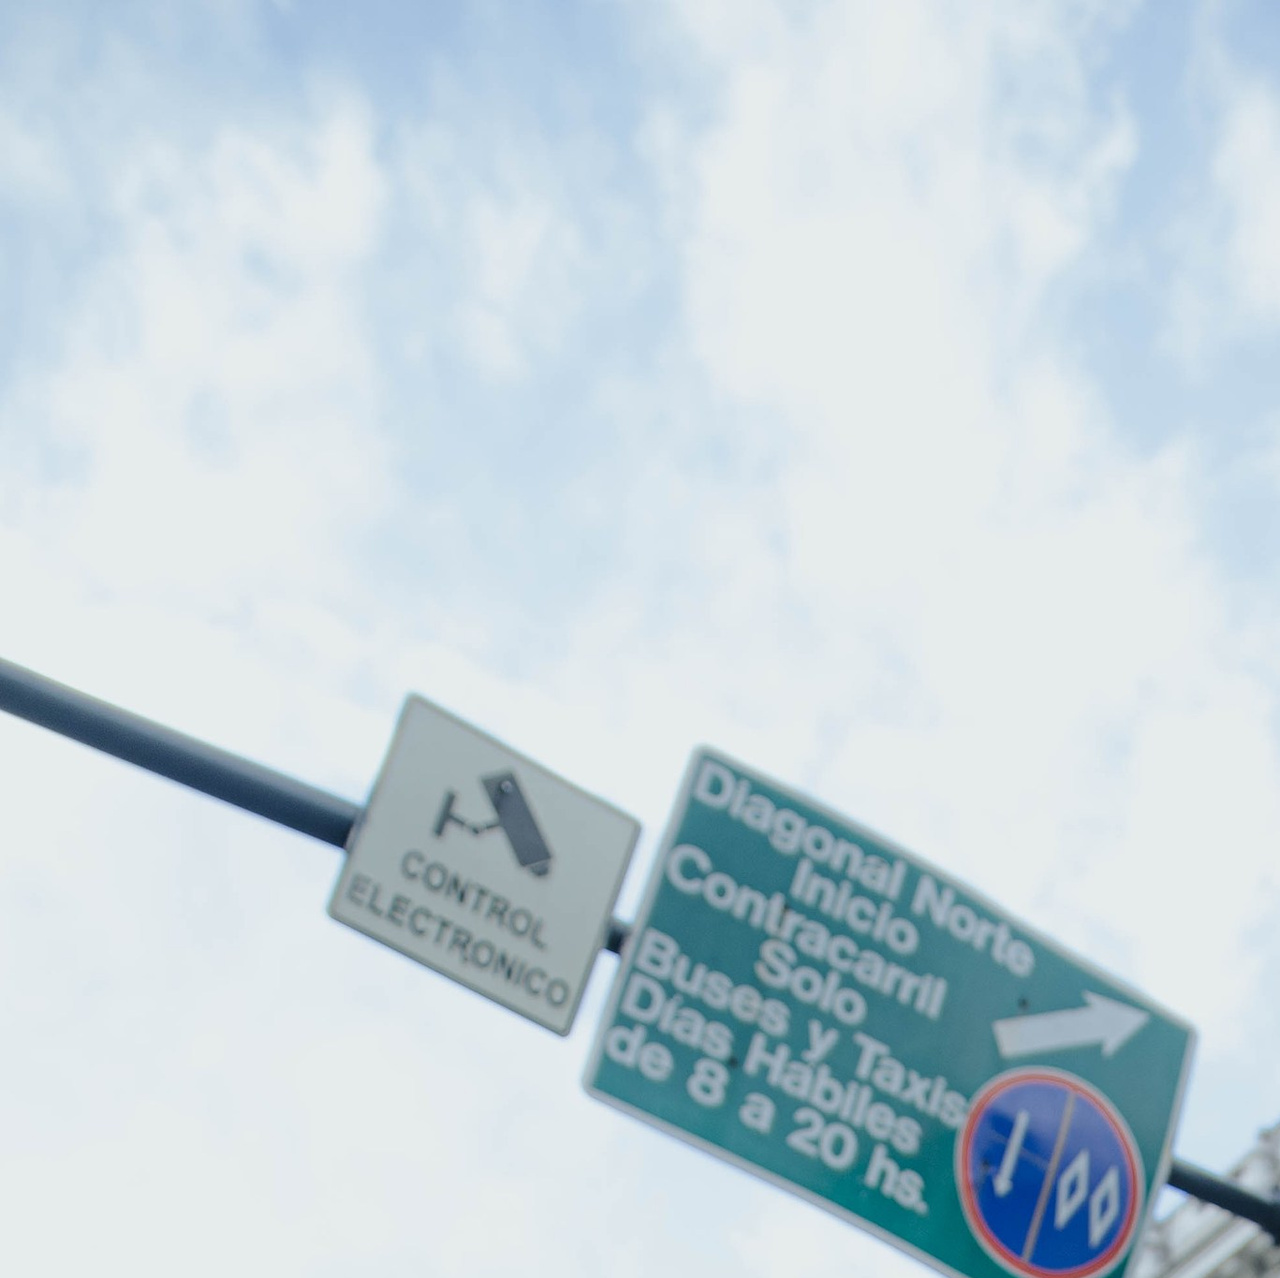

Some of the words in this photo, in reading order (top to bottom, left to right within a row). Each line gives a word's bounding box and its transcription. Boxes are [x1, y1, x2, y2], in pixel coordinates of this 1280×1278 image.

[401, 849, 548, 951] CONTROL
[665, 843, 948, 1021] Contracarril
[695, 759, 908, 900] Diagonal
[910, 873, 1036, 978] Norte
[789, 856, 919, 956] Inicio
[347, 872, 571, 1008] ELECTRONICO
[753, 938, 868, 1026] Solo
[604, 1022, 675, 1083] de
[686, 1057, 730, 1107] 8
[738, 1092, 776, 1135] a
[785, 1106, 859, 1171] 20
[635, 926, 791, 1038] Buses
[801, 1018, 840, 1062] y
[852, 1030, 970, 1131] Taxis
